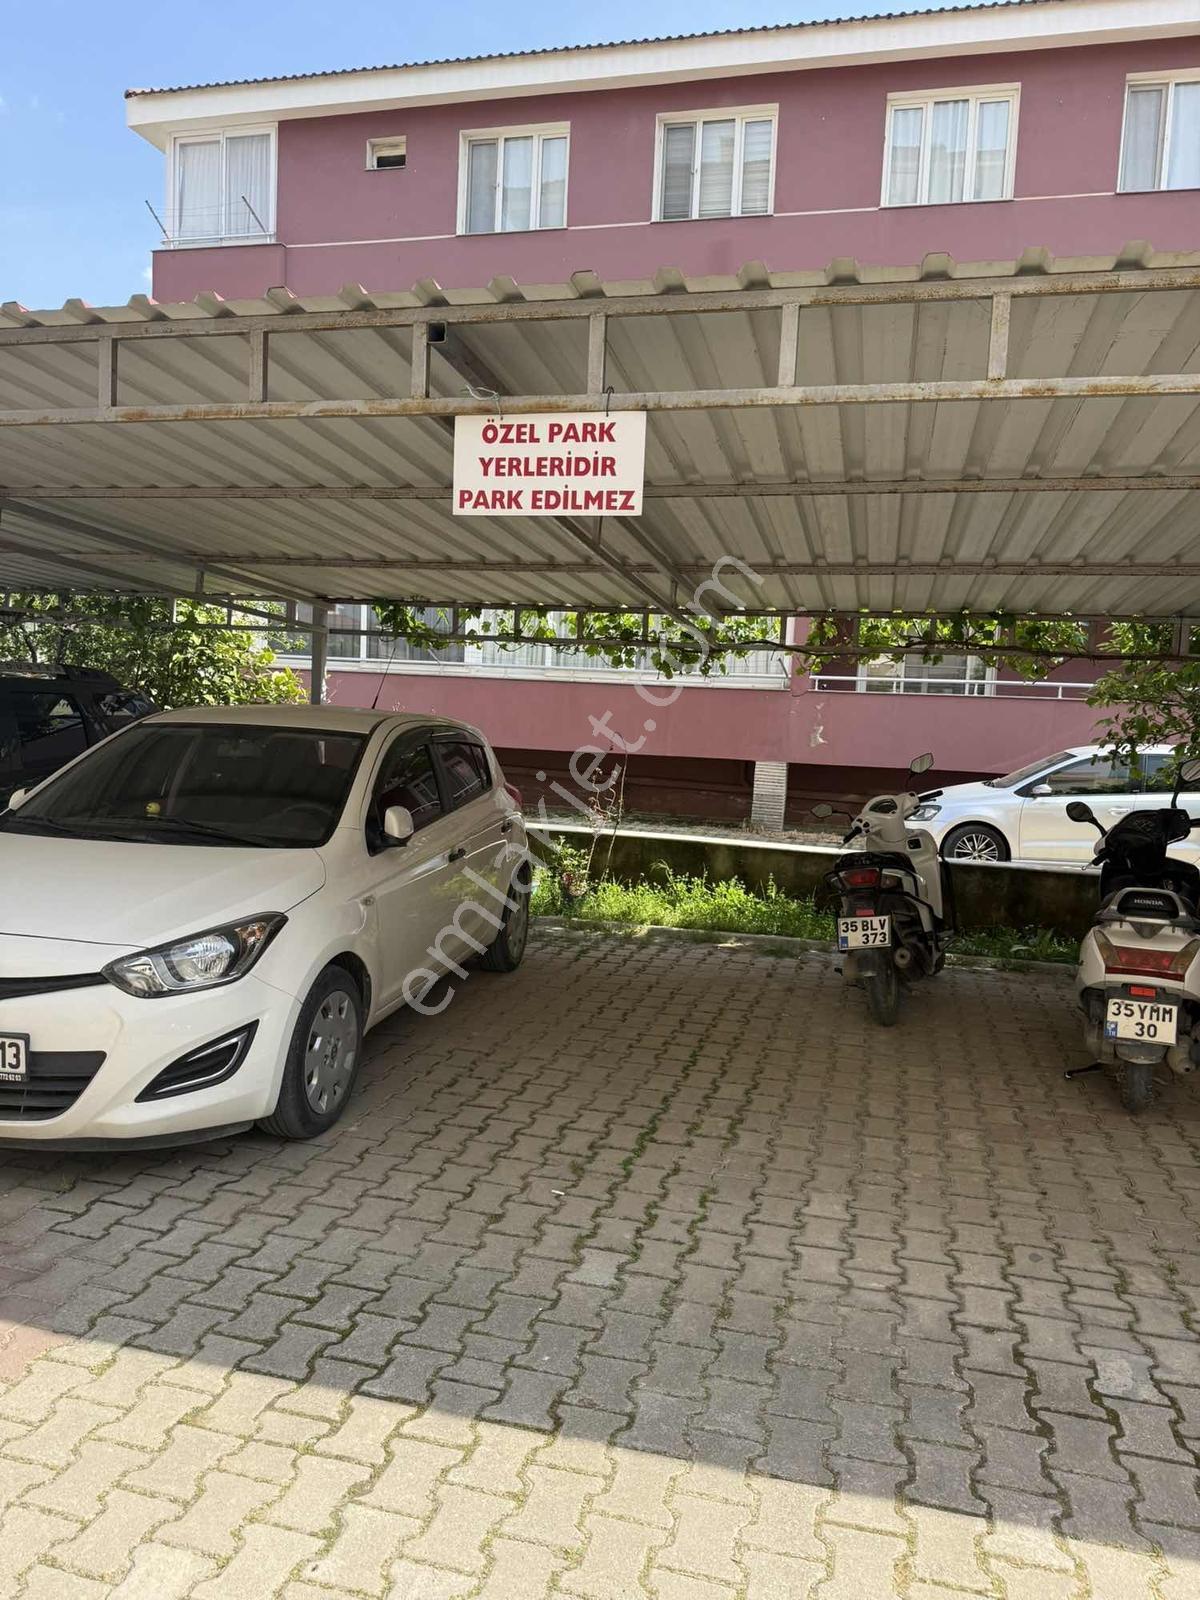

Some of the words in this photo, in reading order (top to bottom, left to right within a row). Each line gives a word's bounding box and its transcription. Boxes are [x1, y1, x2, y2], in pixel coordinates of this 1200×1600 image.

[482, 418, 540, 444] ÖZEL
[548, 422, 616, 443] PARK
[479, 450, 617, 477] YERLERİDİR
[459, 489, 523, 510] PARK
[530, 484, 635, 511] EDİLMEZ
[841, 921, 858, 933] 35
[861, 919, 886, 931] BLV
[862, 932, 887, 944] 373
[1135, 1022, 1157, 1038] 30
[0, 1041, 21, 1069] 13
